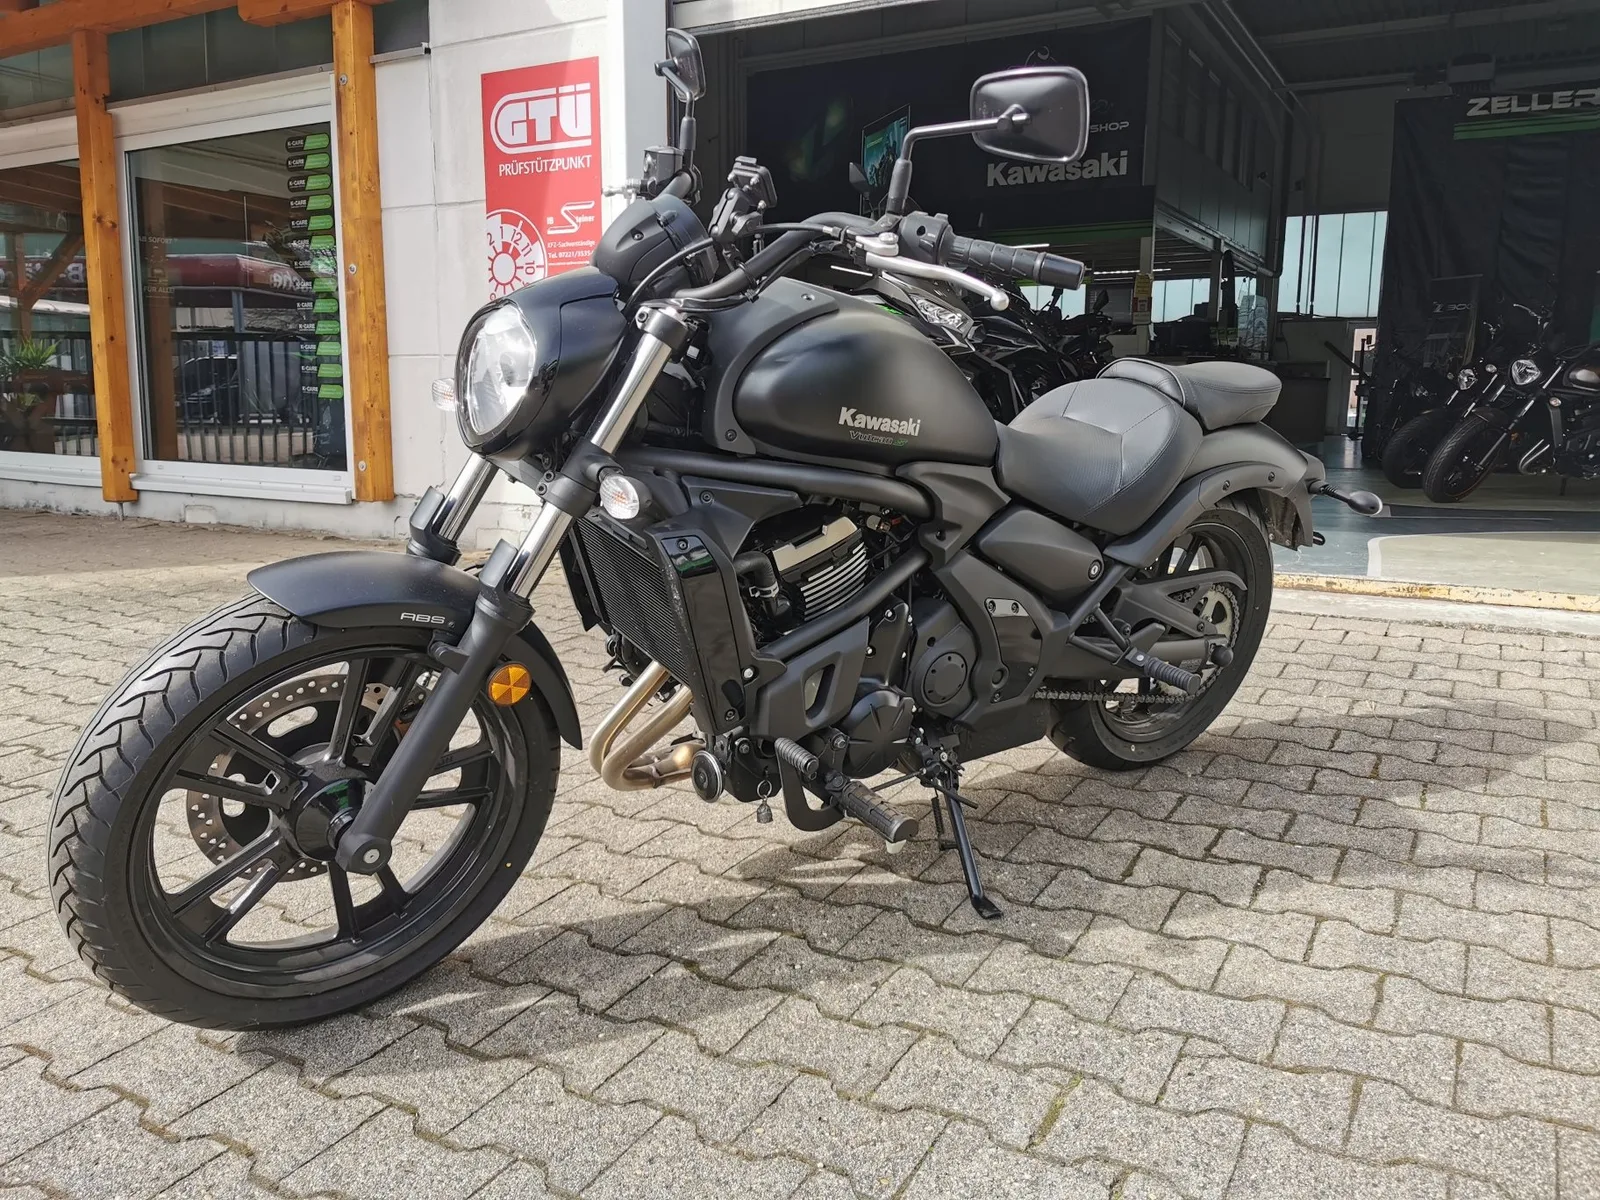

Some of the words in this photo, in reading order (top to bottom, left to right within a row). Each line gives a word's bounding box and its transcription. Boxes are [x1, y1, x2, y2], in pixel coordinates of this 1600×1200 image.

[1466, 88, 1600, 117] ZELLER
[496, 82, 592, 144] GTÜ
[1090, 121, 1130, 133] SHOP
[499, 155, 592, 177] PRÜFSTÜTZPUNKT
[987, 150, 1128, 187] Kawasaki
[487, 232, 495, 246] 2
[500, 226, 503, 239] 1
[511, 229, 523, 246] 12
[521, 243, 532, 257] 11
[525, 260, 535, 275] 10
[838, 406, 921, 437] Kawasaki
[400, 612, 446, 624] ABS
